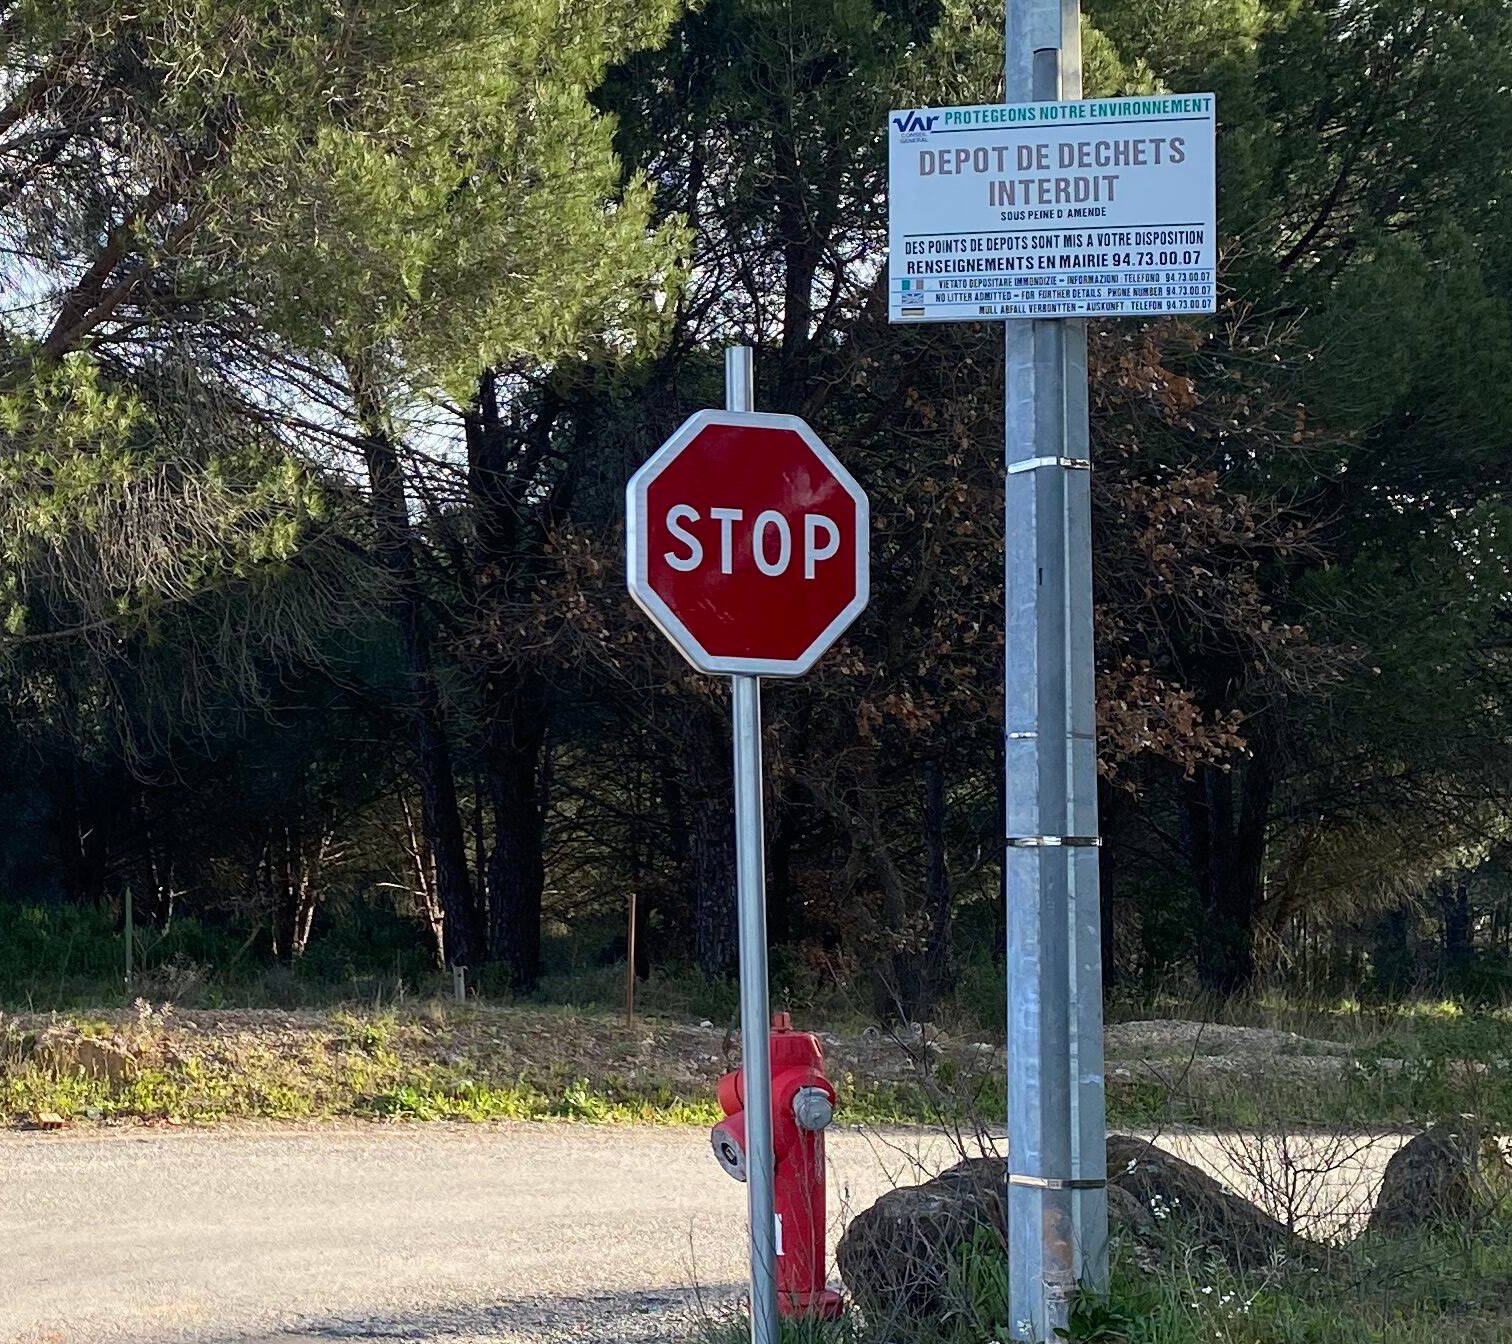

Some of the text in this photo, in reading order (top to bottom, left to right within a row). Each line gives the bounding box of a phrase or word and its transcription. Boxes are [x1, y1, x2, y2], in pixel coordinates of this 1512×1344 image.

[945, 98, 1212, 125] PROTEGEONS NOTRE ENVIRONNEMENT
[919, 137, 1186, 176] DEPOT DE DECHETS
[989, 174, 1120, 207] INTERDIT
[1000, 210, 1026, 221] SOUS
[1028, 209, 1054, 220] PEINE
[1067, 207, 1107, 218] AMENDE
[905, 230, 1204, 255] DES POINTS DE DEPOTS SONT MIS A VOTRE DISPOSITION
[907, 250, 1201, 275] RENSEIGNEMENTS EN MAIRIE 94.73.00.07
[935, 292, 946, 302] NO
[947, 292, 973, 302] LITTER
[974, 291, 1012, 302] ADMITTED
[1021, 290, 1035, 300] FOR
[664, 504, 841, 580] STOP
